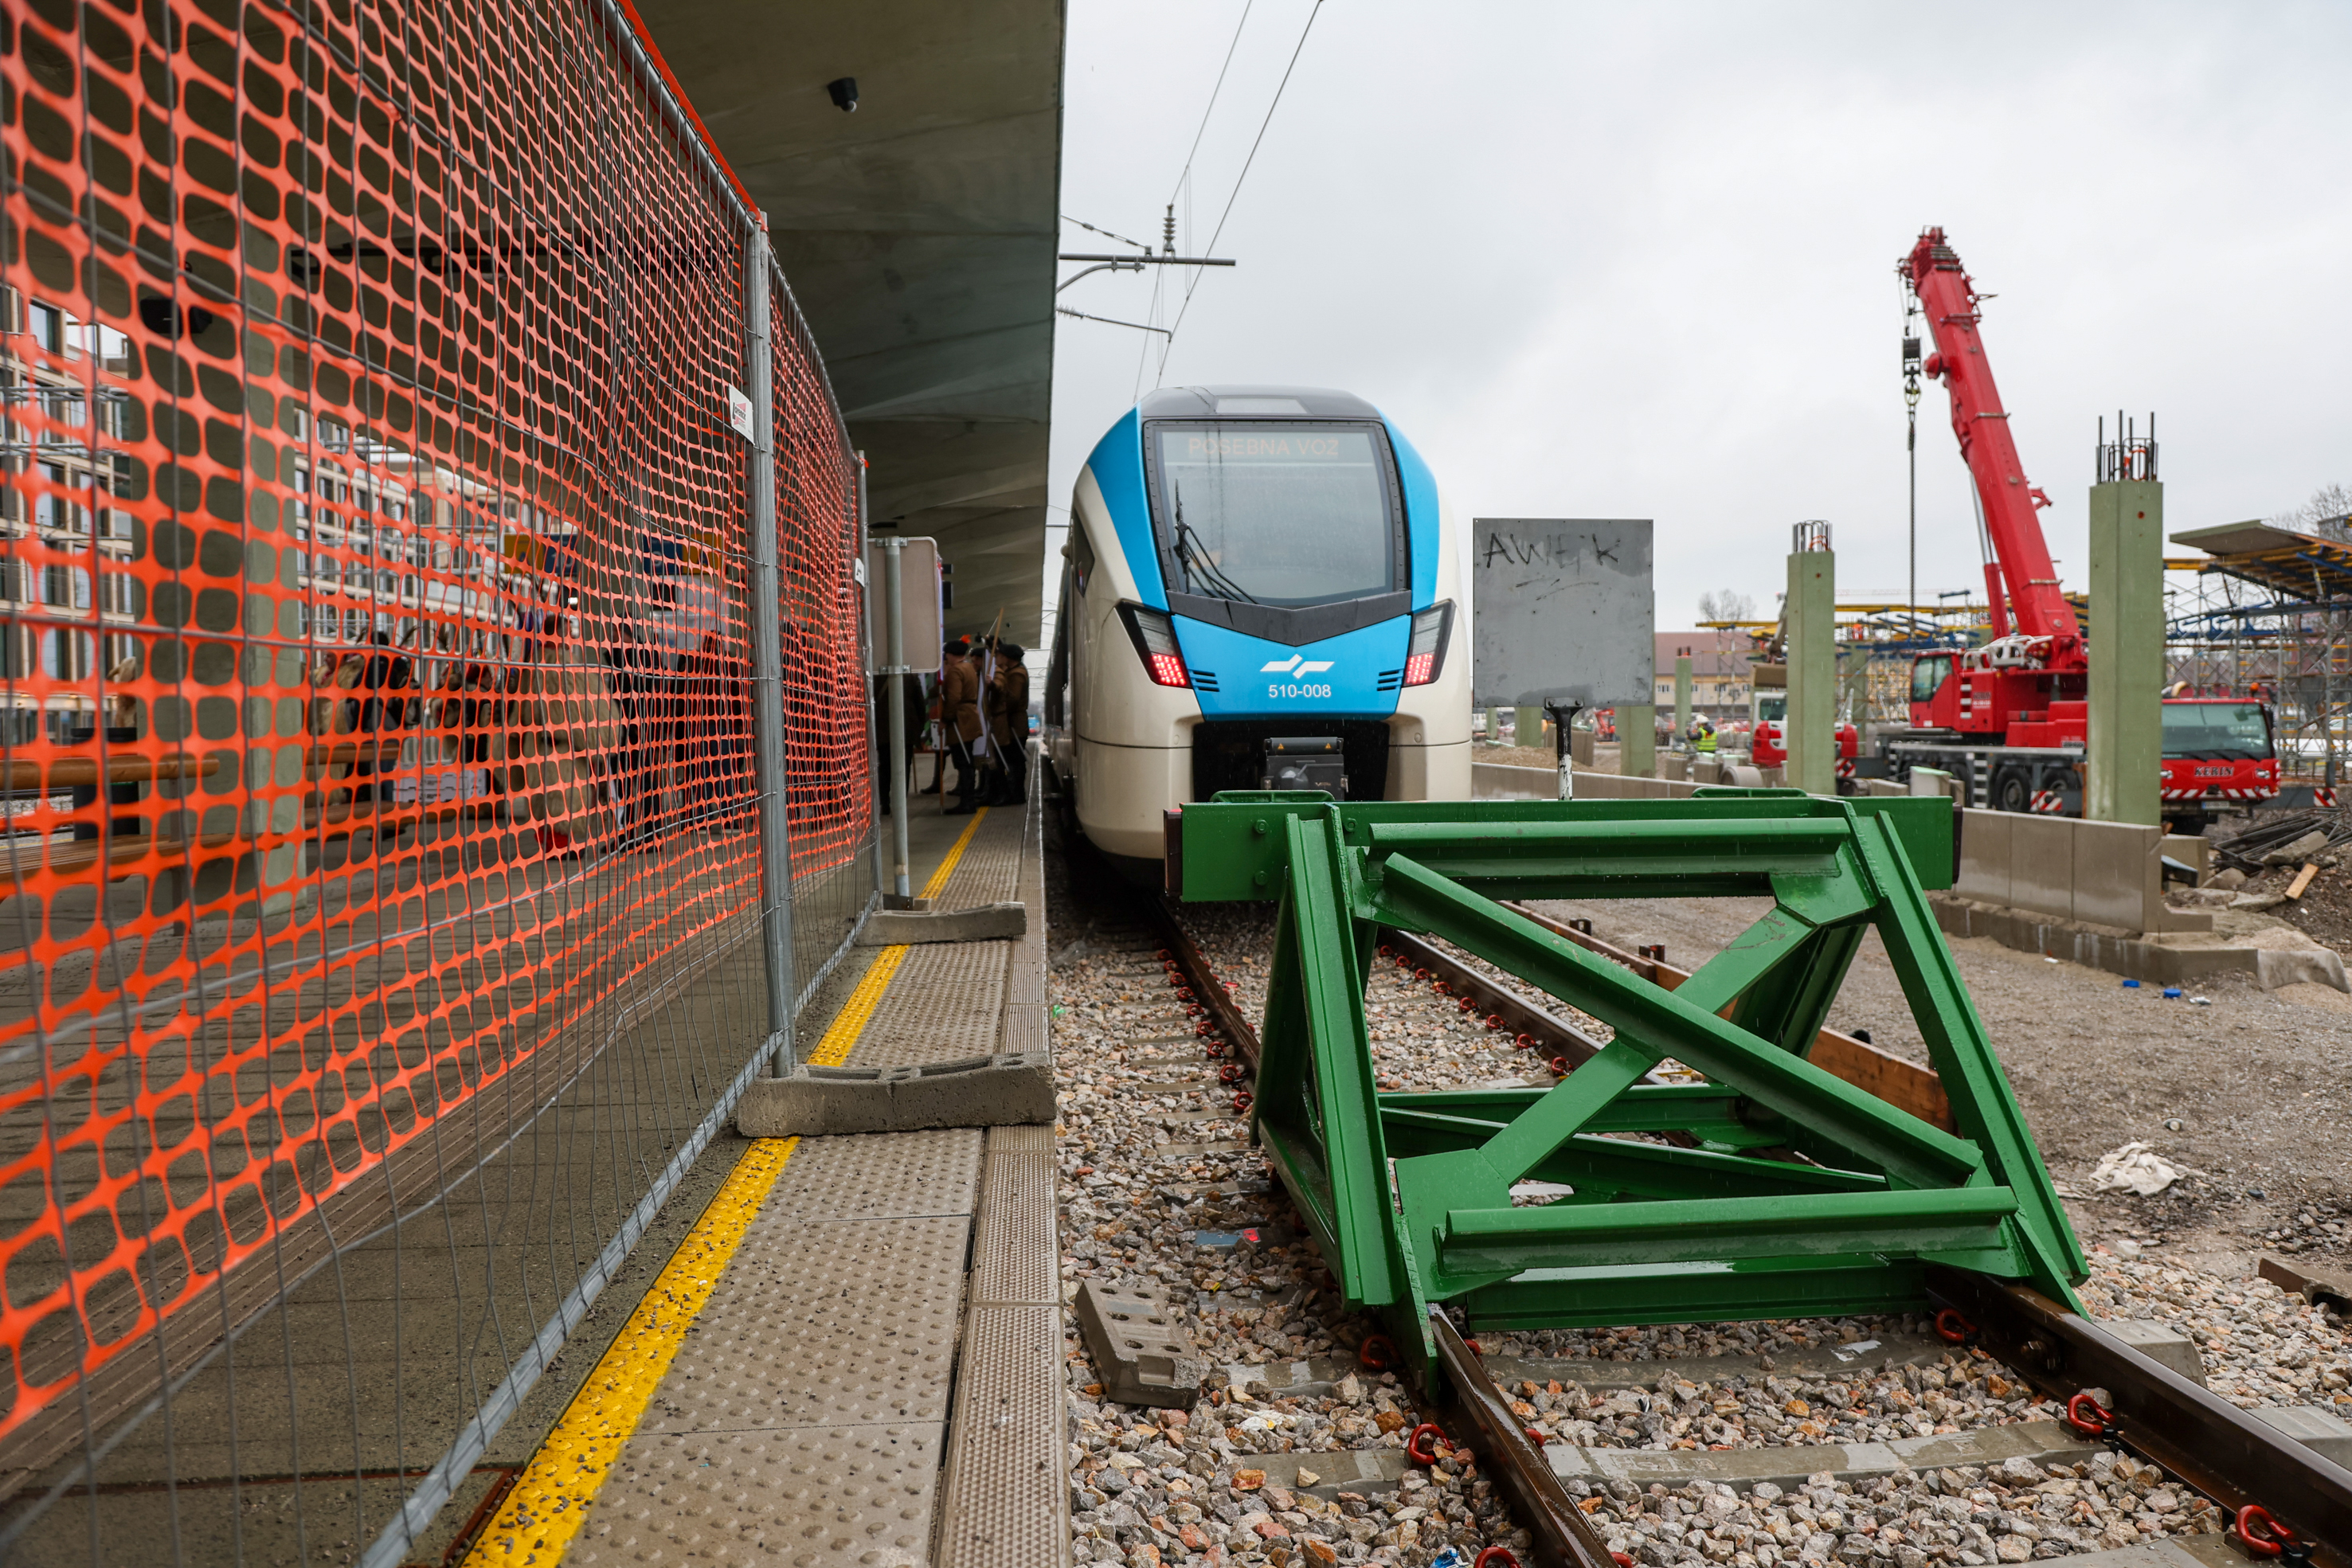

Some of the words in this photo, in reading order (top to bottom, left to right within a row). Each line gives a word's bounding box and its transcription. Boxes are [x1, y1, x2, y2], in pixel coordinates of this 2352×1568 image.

[1189, 438, 1290, 455] POSEBNA
[1269, 684, 1332, 698] 510-008
[2194, 766, 2234, 777] KERIN
